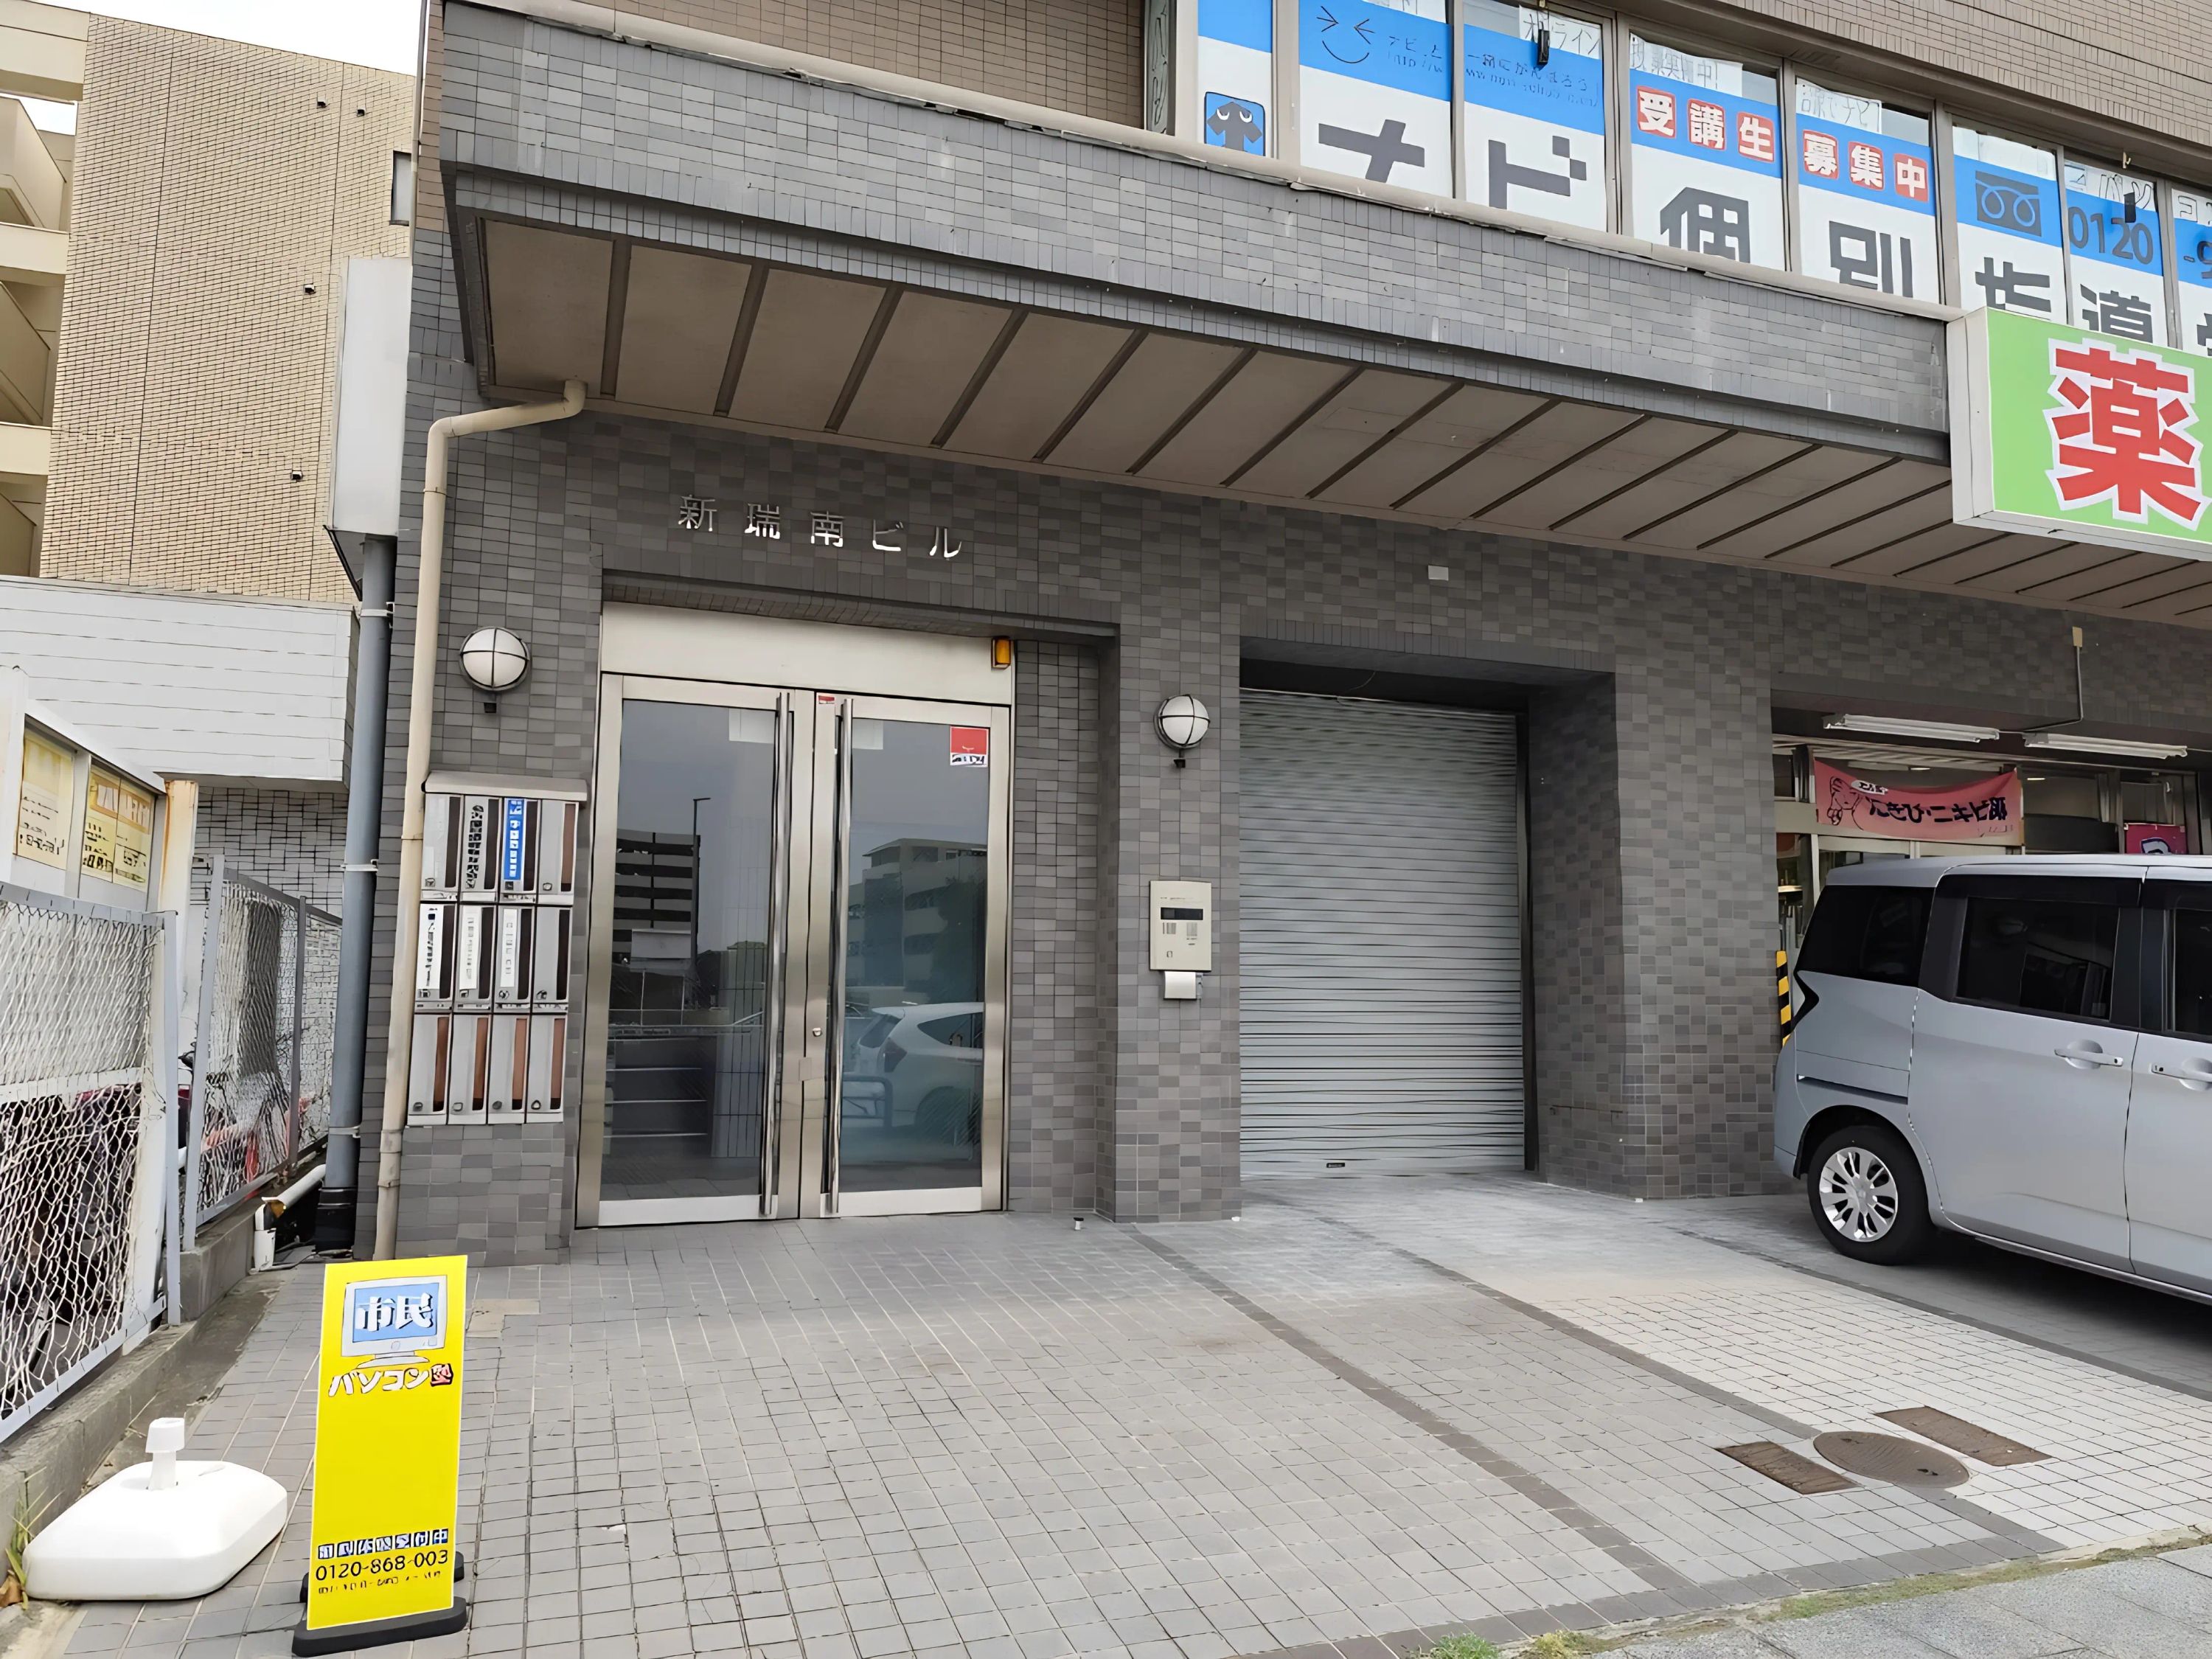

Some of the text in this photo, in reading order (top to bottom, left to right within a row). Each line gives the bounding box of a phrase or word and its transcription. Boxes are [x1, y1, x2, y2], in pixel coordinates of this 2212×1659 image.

[2067, 206, 2154, 265] 0120
[2048, 341, 2205, 526] 薬
[678, 494, 961, 558] 新瑞南ビル
[355, 1293, 434, 1332] 市民
